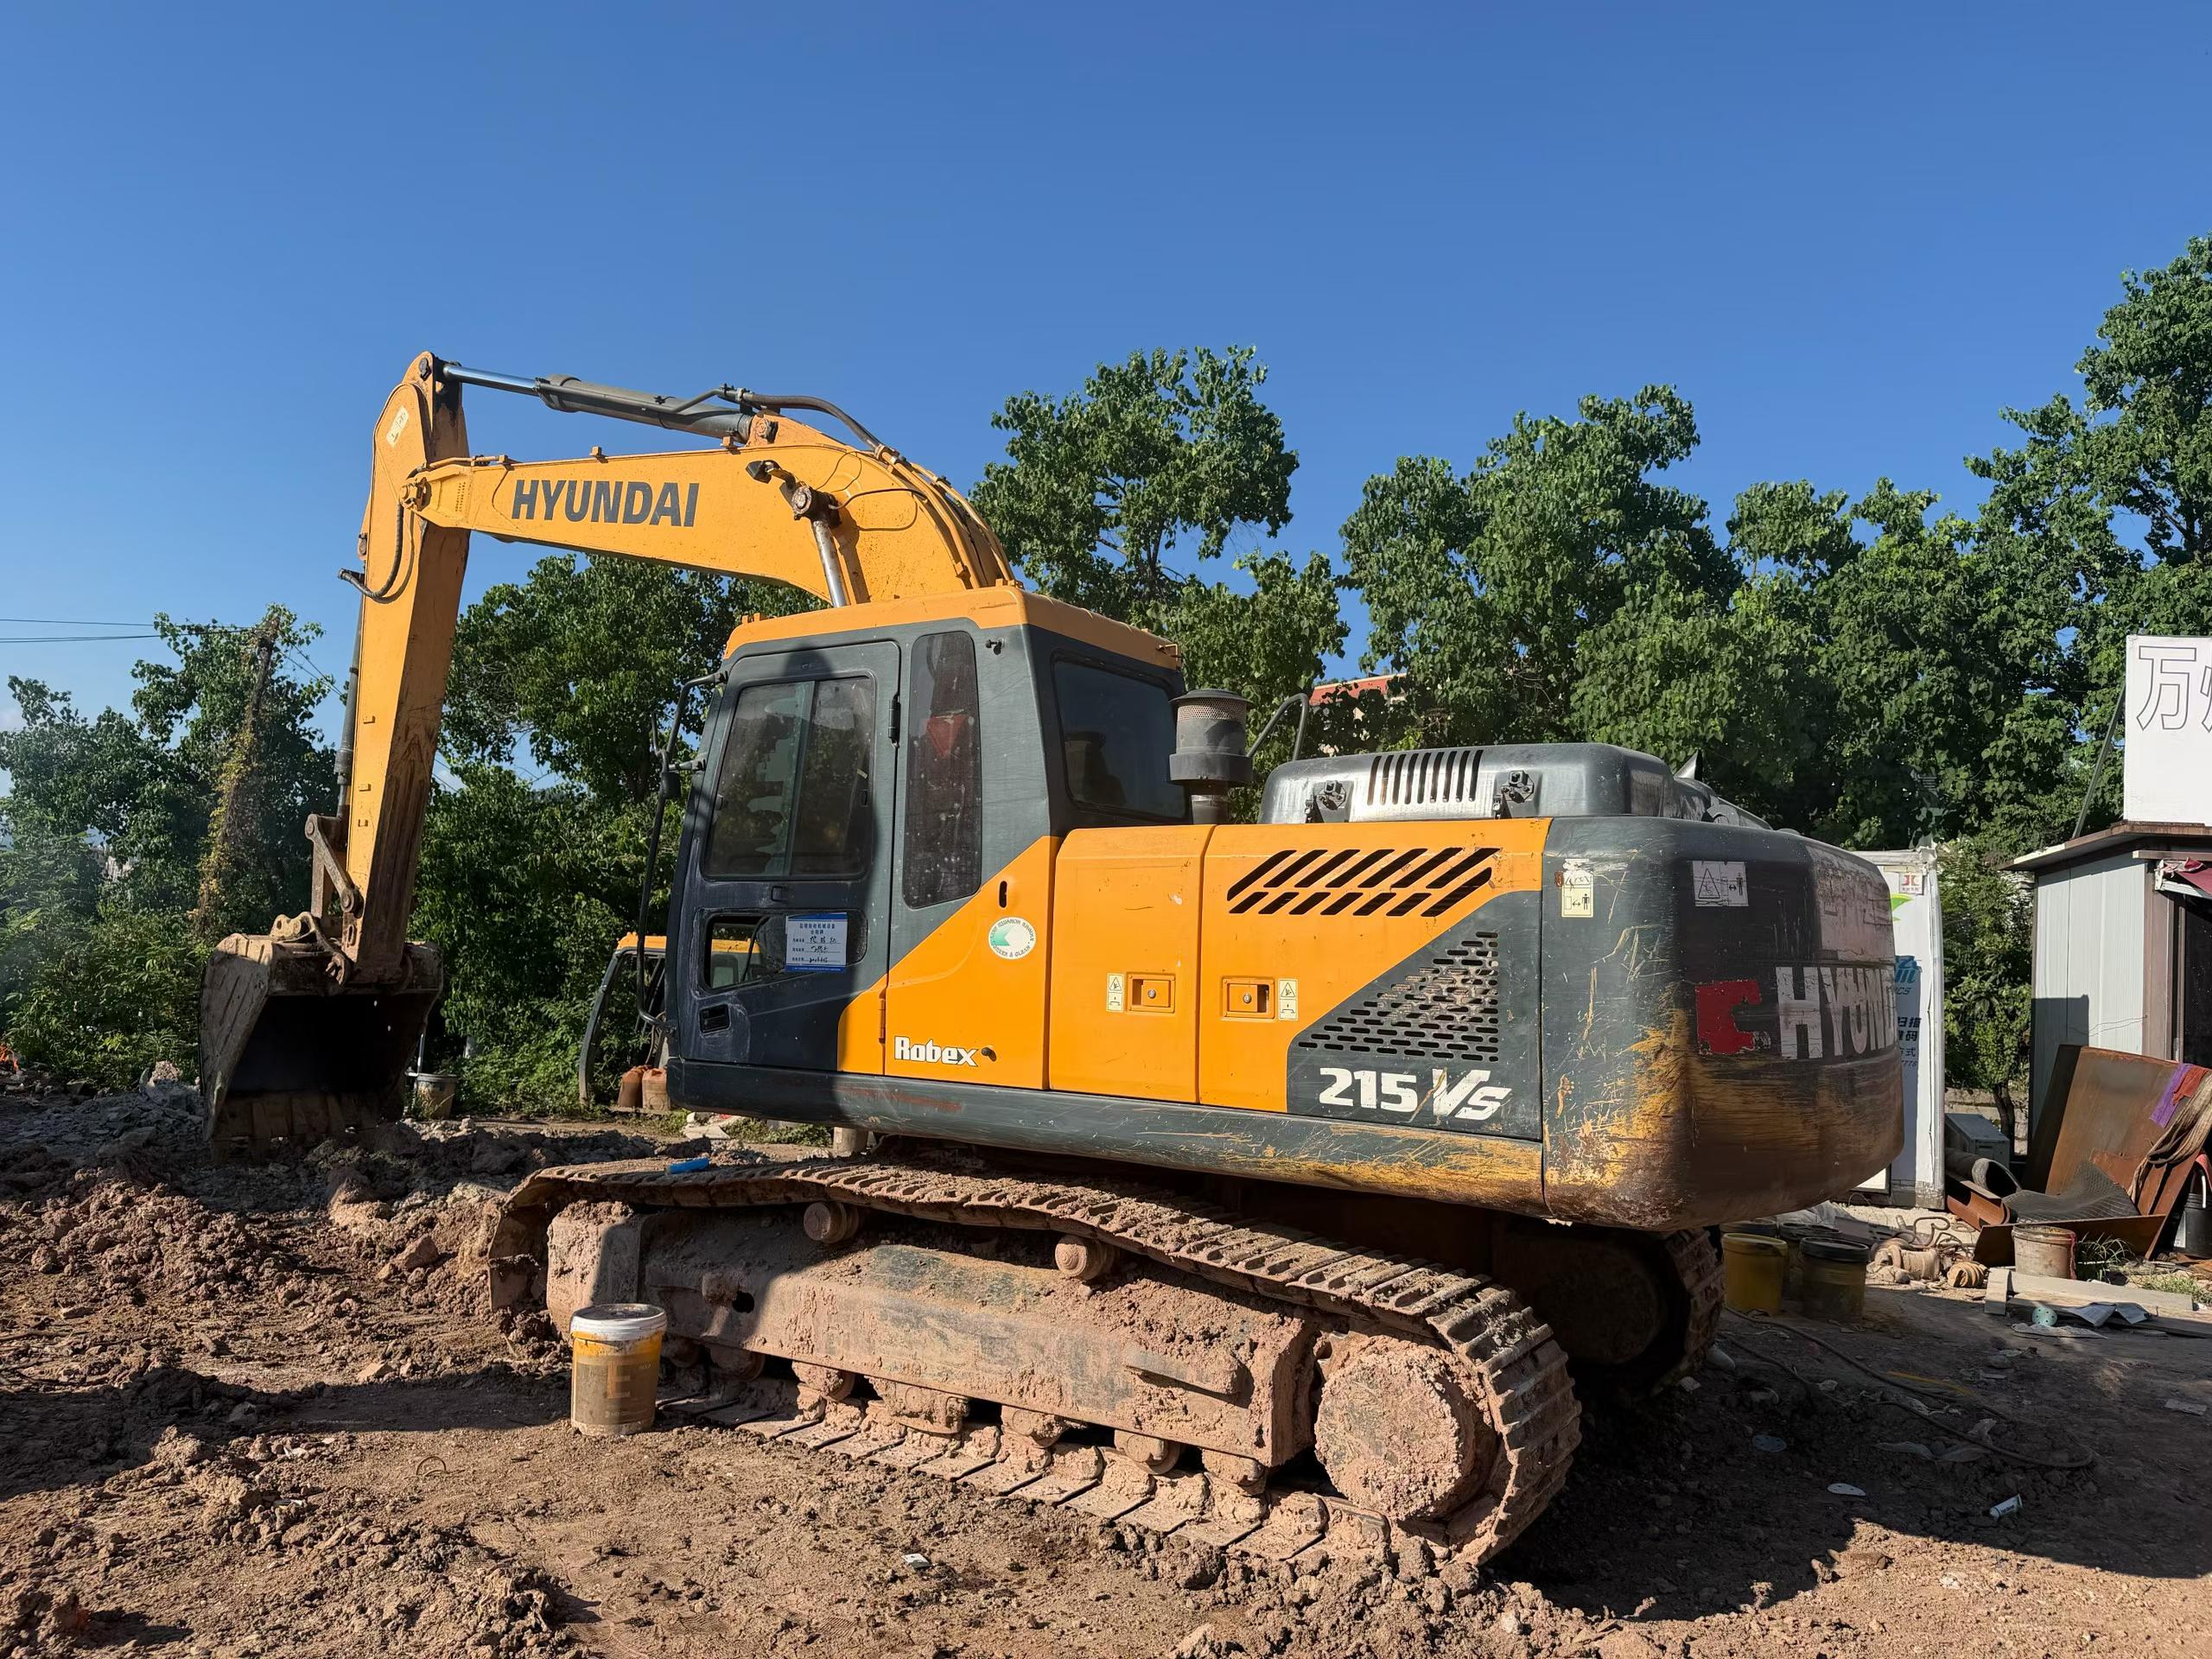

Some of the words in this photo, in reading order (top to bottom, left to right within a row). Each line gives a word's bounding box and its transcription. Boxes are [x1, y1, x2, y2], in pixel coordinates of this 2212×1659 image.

[512, 480, 700, 527] HYUNDAI
[2137, 645, 2212, 733] 万
[894, 1036, 978, 1067] Robex
[1319, 1068, 1418, 1112] 215
